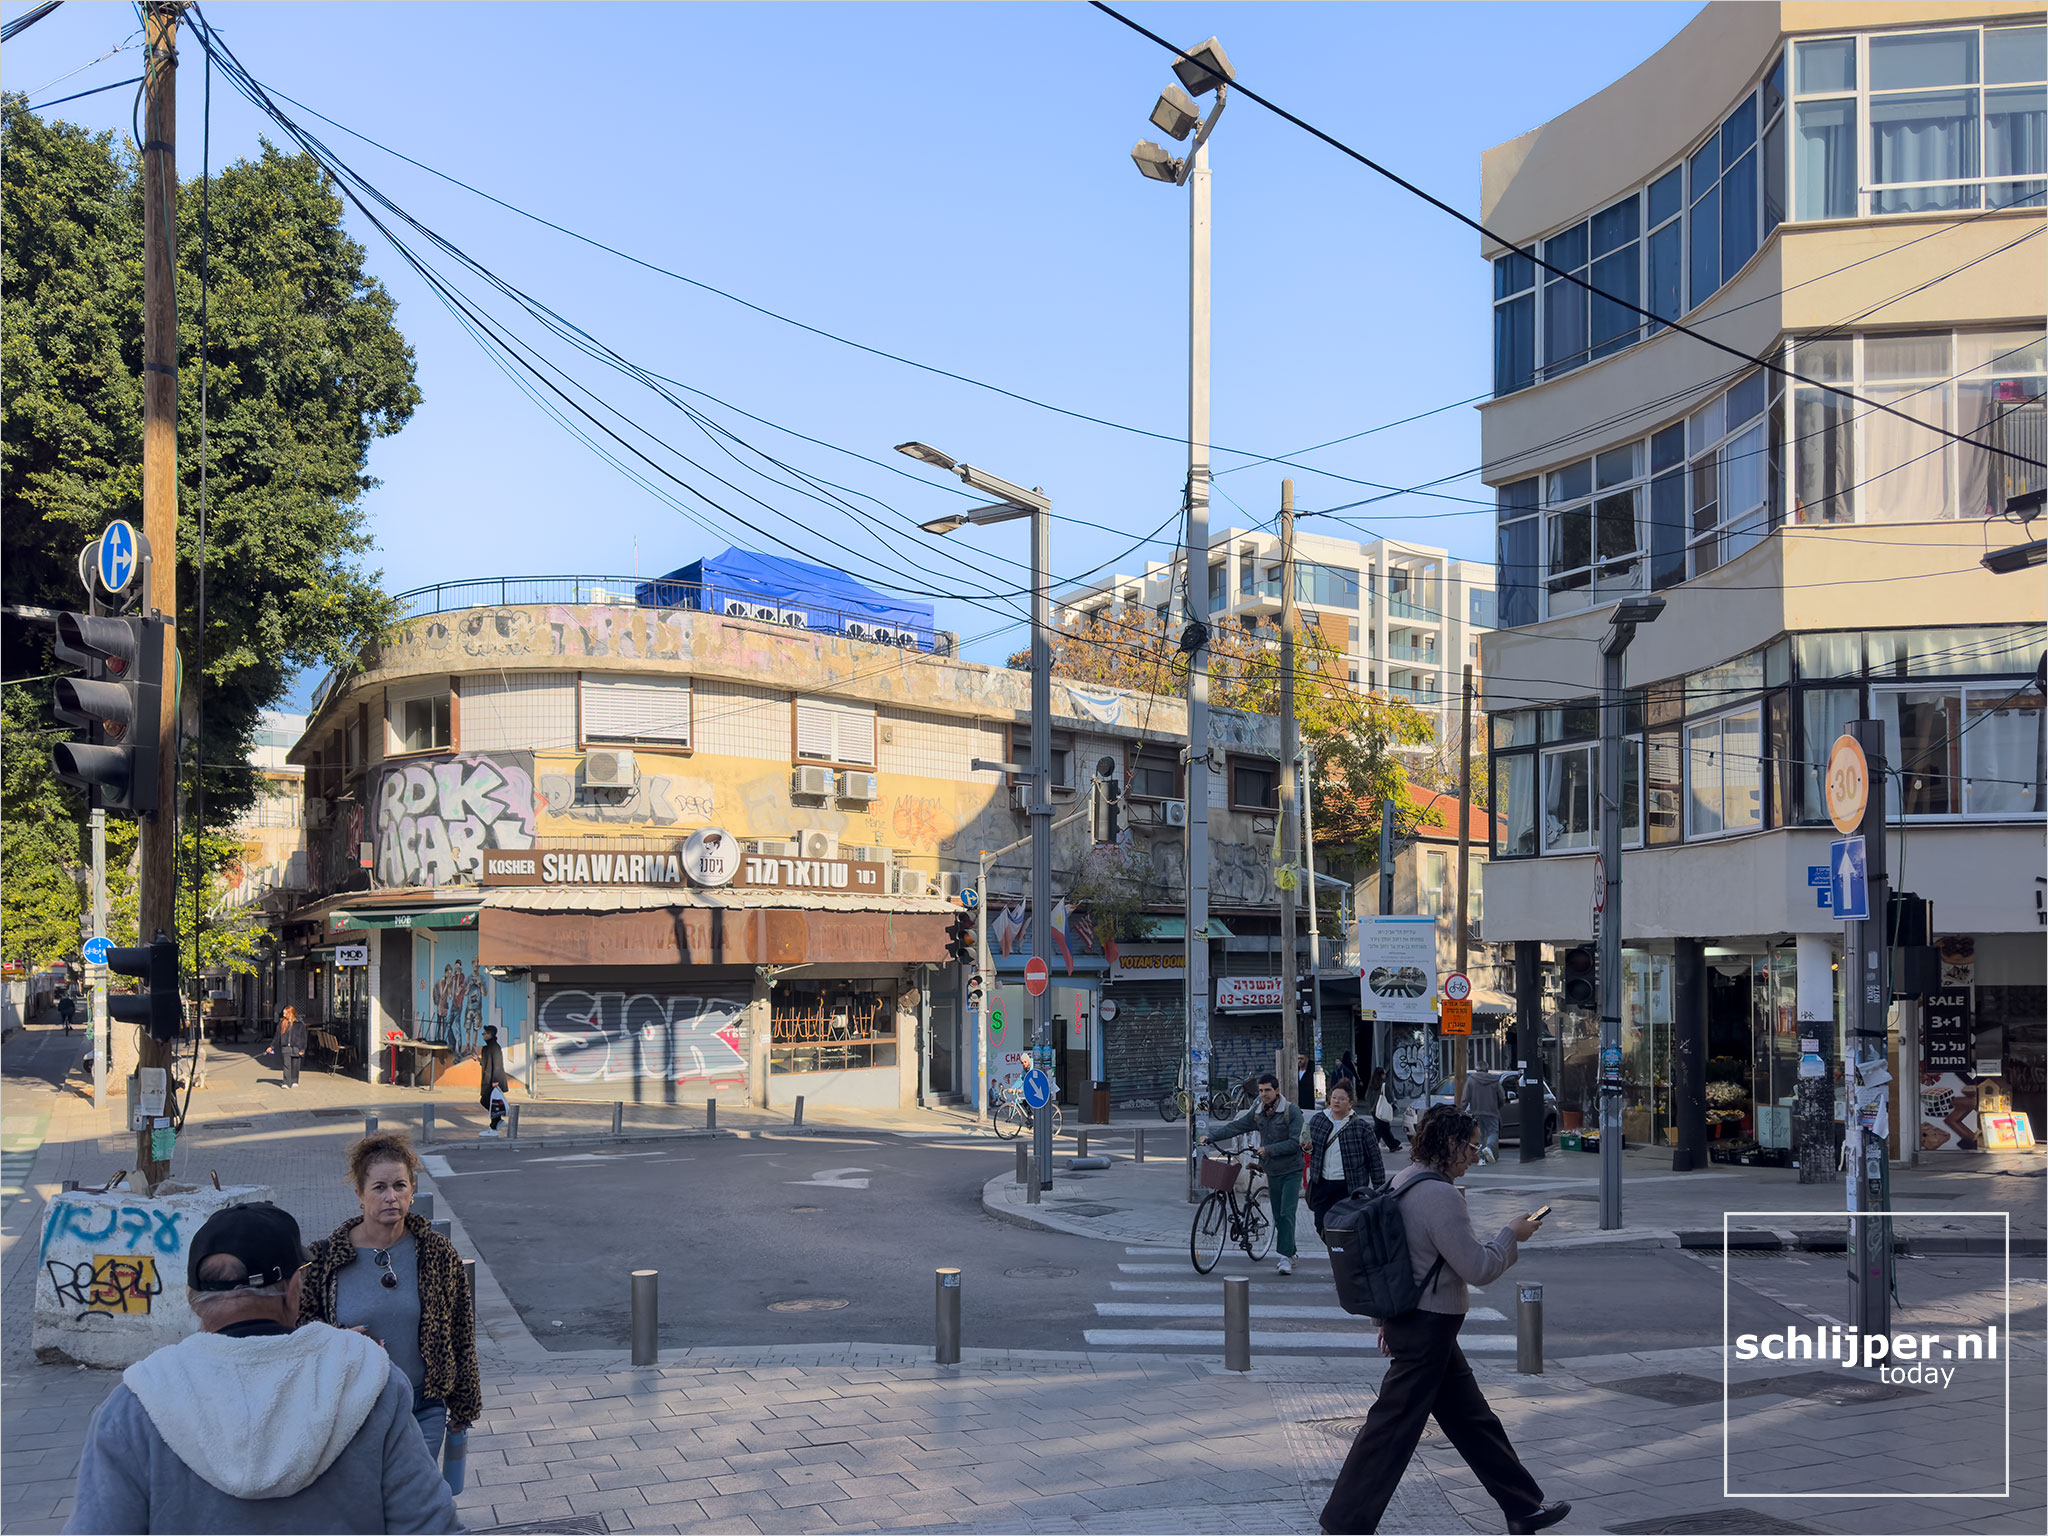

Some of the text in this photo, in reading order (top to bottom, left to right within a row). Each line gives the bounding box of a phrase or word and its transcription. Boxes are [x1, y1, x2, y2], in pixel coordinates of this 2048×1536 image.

[1834, 764, 1858, 803] 30
[488, 853, 681, 884] KOSHER SHAWARMA
[745, 857, 877, 889] שווארמה כשר
[394, 915, 412, 925] MOB
[340, 950, 364, 959] MOB
[1120, 954, 1161, 969] YOTAM'S
[1928, 995, 1965, 1007] SALE
[1931, 1015, 1961, 1028] 3+1
[1931, 1041, 1966, 1051] על כל
[1930, 1056, 1966, 1065] החנות
